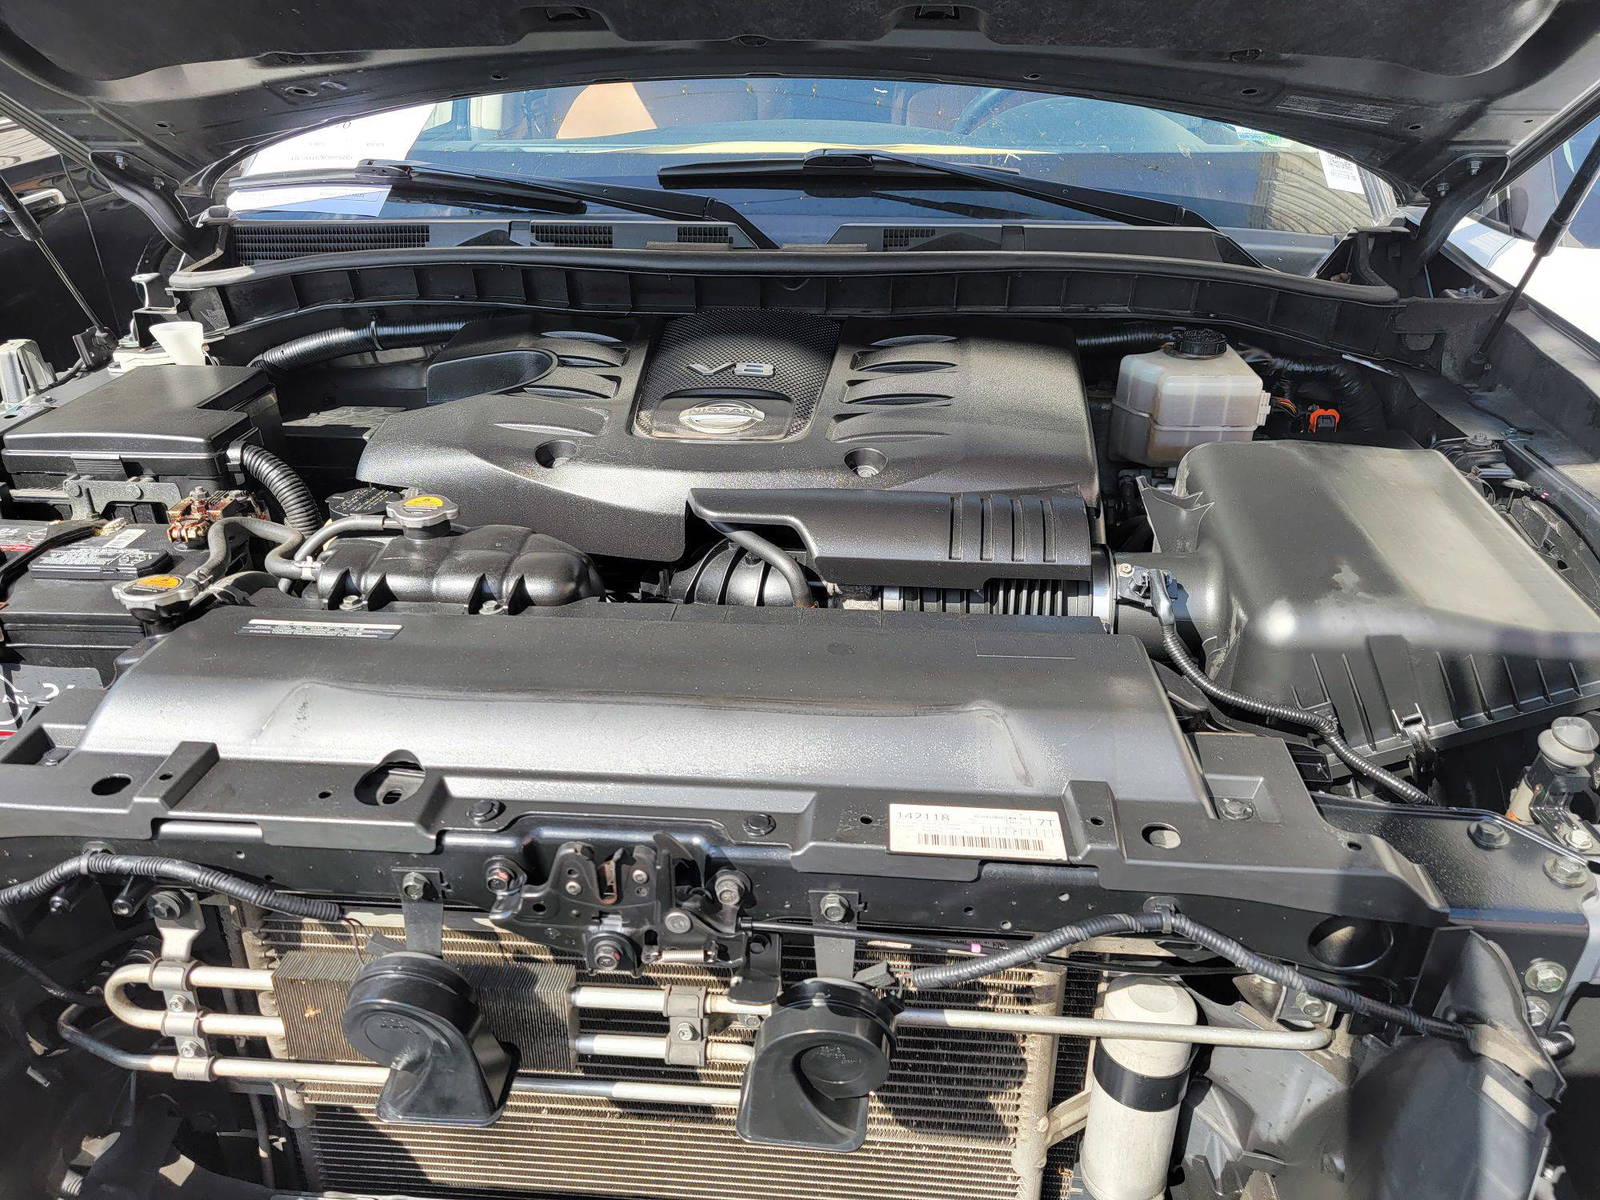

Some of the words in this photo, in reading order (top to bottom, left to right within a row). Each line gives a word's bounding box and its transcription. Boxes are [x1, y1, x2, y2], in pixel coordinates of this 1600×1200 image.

[686, 361, 775, 377] V8
[688, 406, 756, 417] NISSAN
[896, 811, 951, 821] 142118
